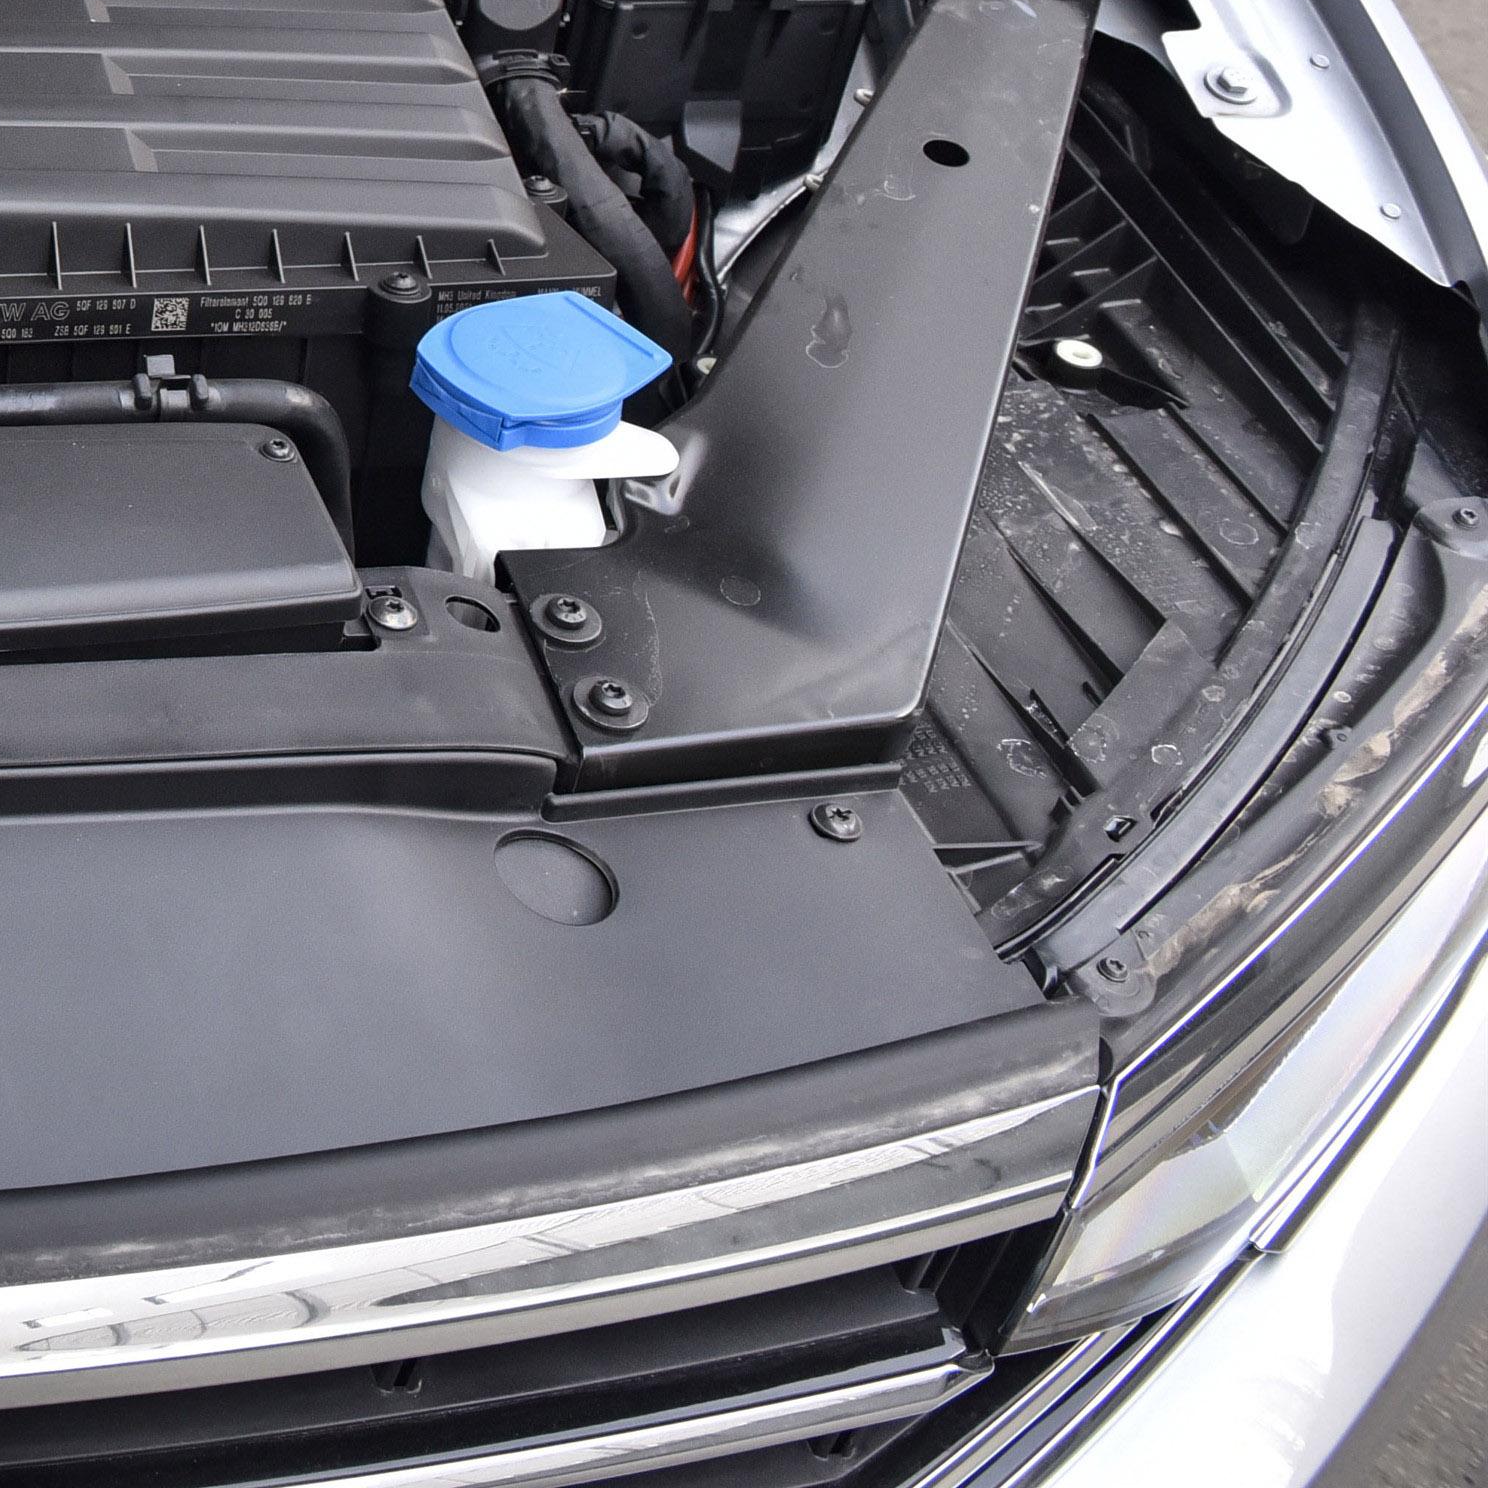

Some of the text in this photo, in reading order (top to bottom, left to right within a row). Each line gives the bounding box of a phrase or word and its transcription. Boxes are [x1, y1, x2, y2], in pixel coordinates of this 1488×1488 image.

[30, 301, 70, 321] AG
[235, 309, 241, 319] C
[125, 324, 132, 334] E
